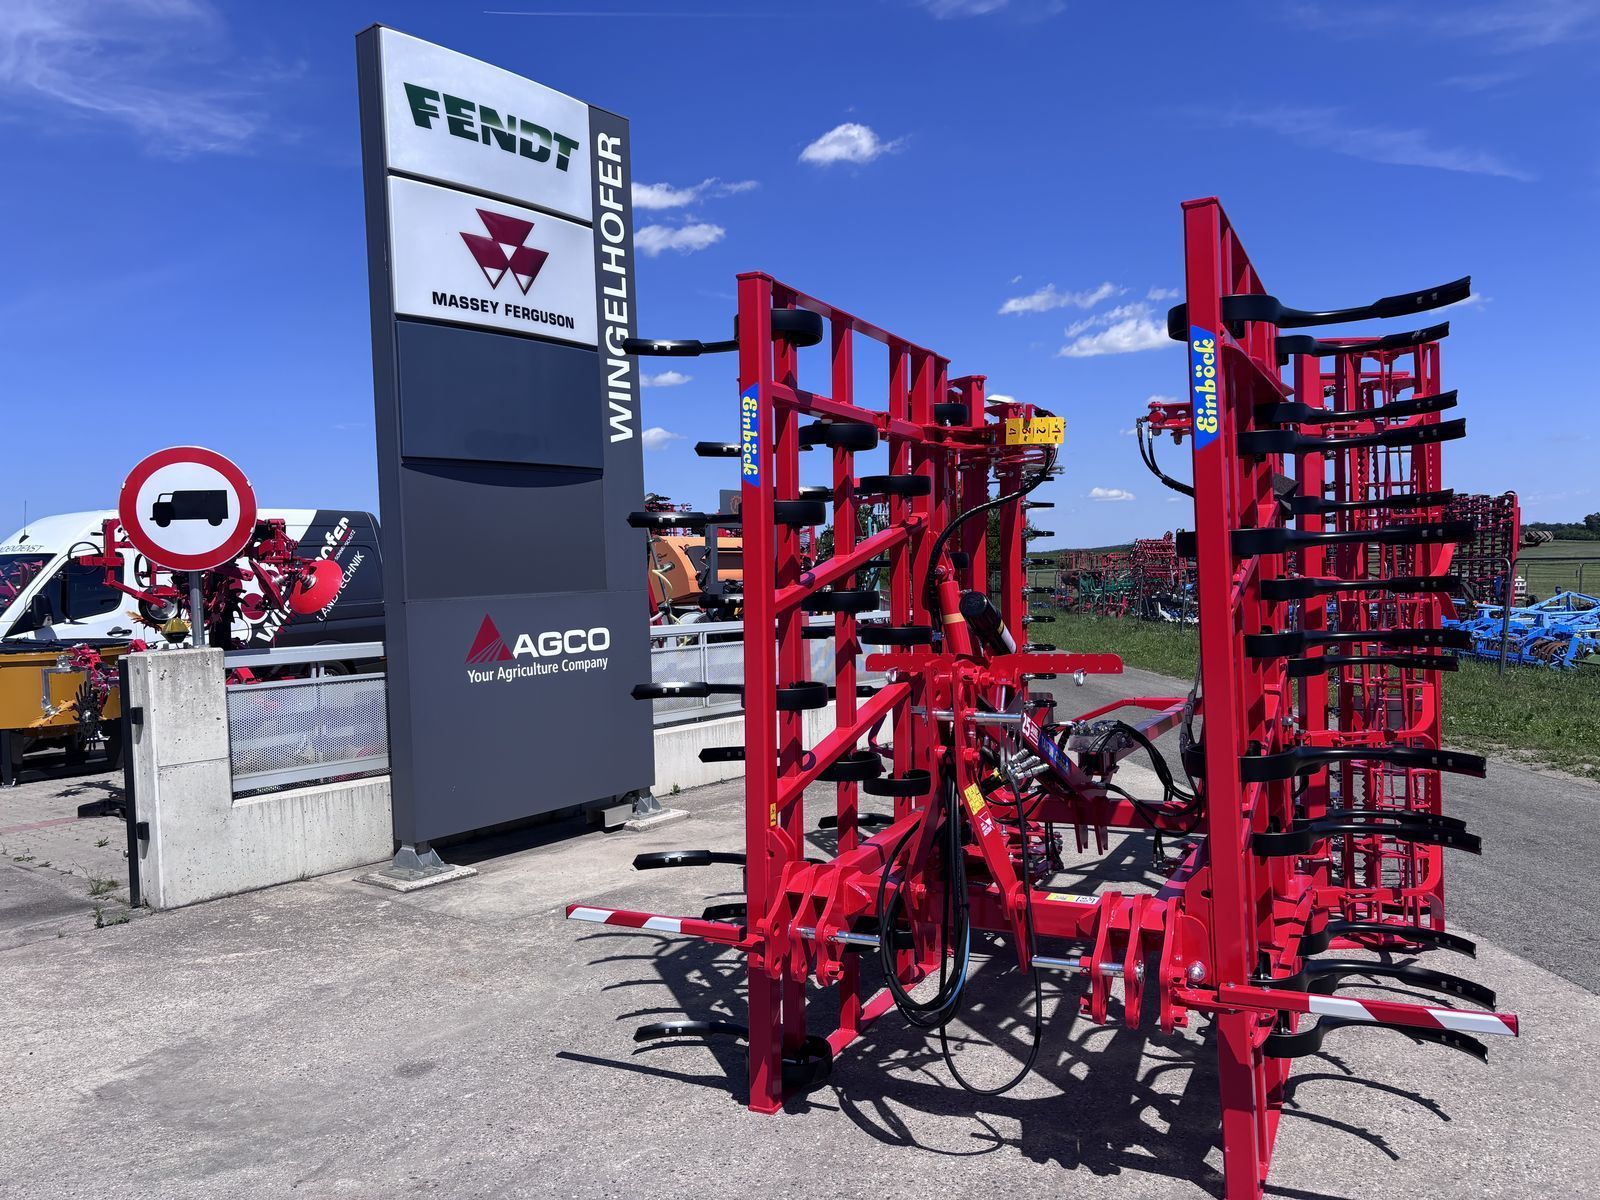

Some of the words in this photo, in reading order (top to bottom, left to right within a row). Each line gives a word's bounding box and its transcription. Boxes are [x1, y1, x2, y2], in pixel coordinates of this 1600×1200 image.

[403, 81, 580, 173] FENDT
[432, 291, 500, 315] MASSEY
[504, 303, 575, 329] FERGUSON
[597, 132, 634, 443] WINGELHOFER
[1193, 338, 1218, 434] Einböck
[742, 396, 759, 475] Einböck
[467, 670, 495, 684] Your
[497, 661, 559, 683] Agriculture
[561, 657, 609, 673] Company
[512, 627, 611, 659] AGCO
